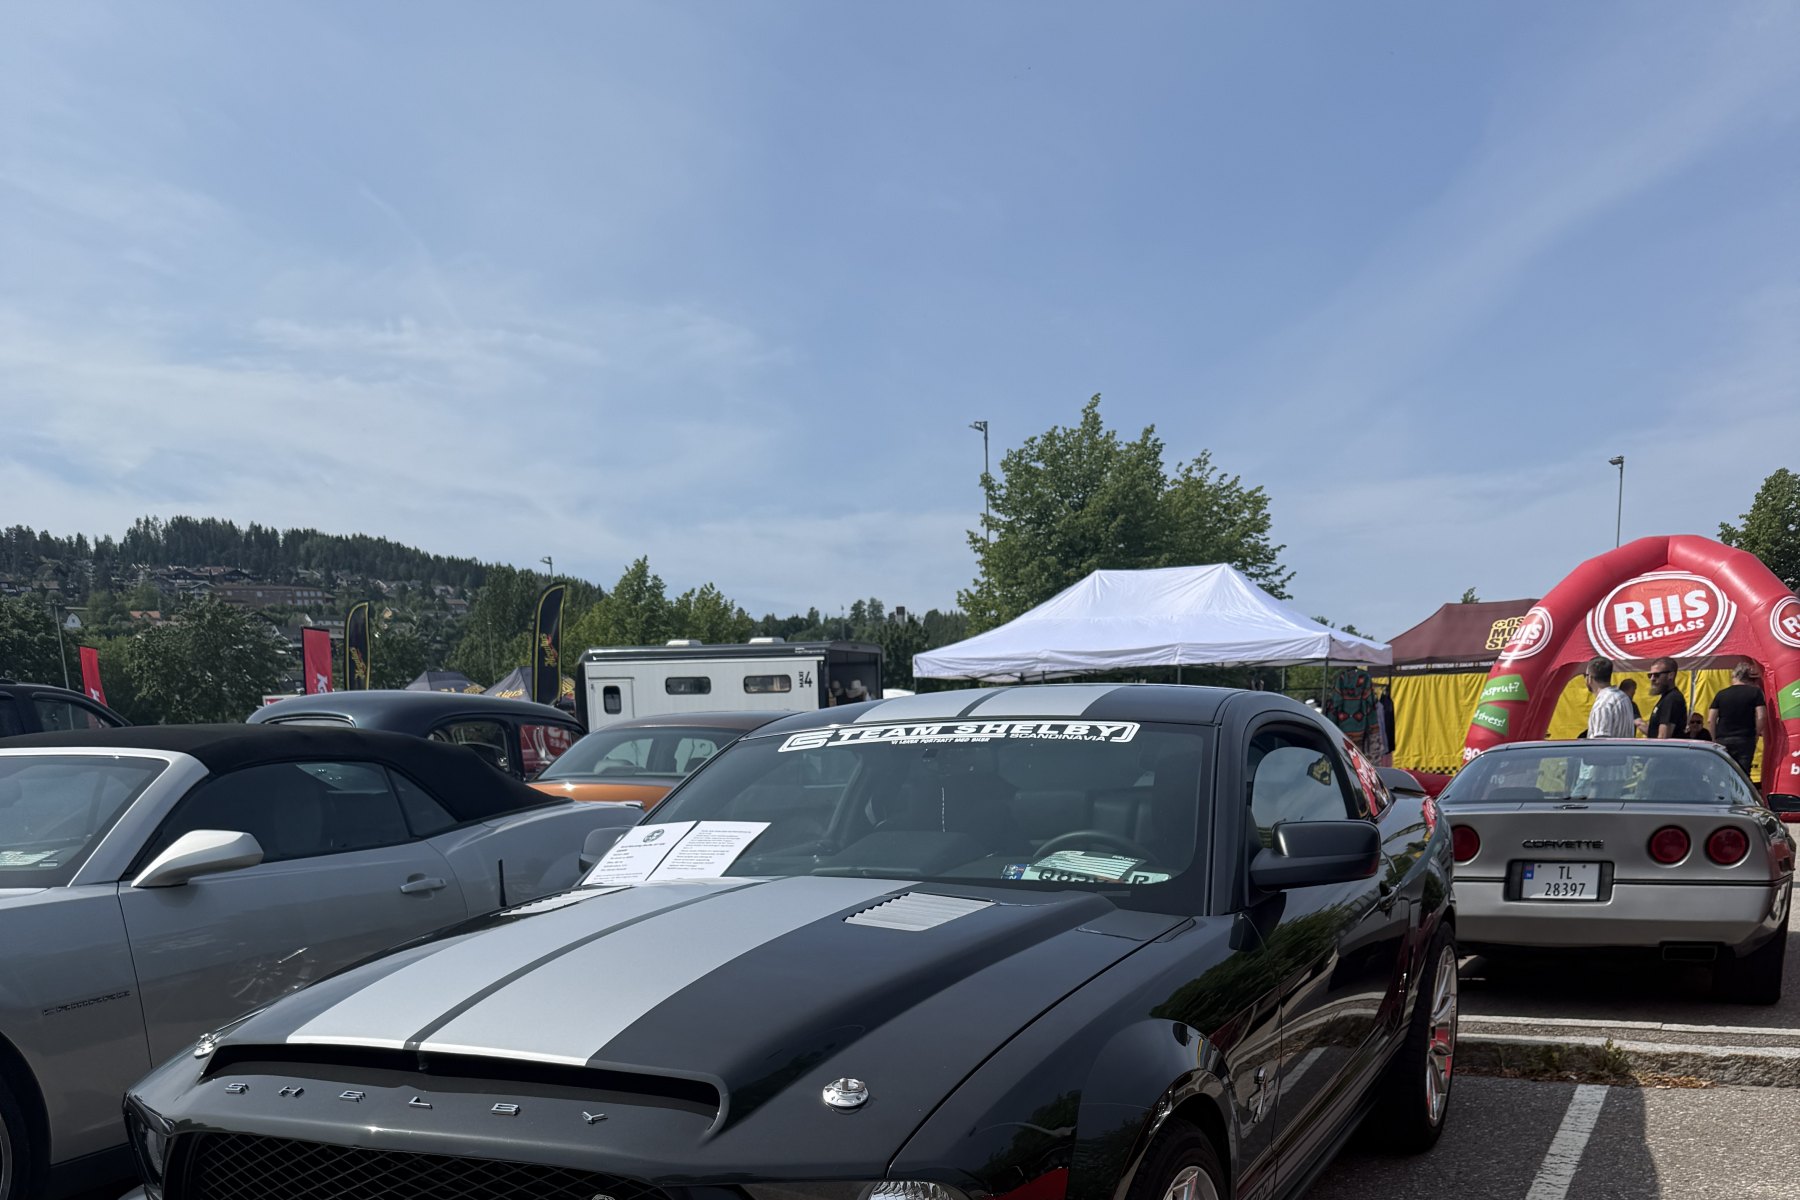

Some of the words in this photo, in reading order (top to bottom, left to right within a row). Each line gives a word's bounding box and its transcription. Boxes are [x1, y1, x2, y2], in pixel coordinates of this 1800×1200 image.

[1613, 589, 1710, 633] RIIS
[1624, 619, 1705, 644] BILGLASS
[804, 671, 812, 688] 4
[838, 726, 941, 742] TEAM
[953, 722, 1127, 738] SHELBY
[1009, 733, 1106, 742] SCANDINAVIA
[1522, 840, 1604, 849] CORVETTE
[1558, 866, 1573, 880] TL
[1544, 882, 1586, 897] 28397
[225, 1081, 609, 1125] SHELBY
